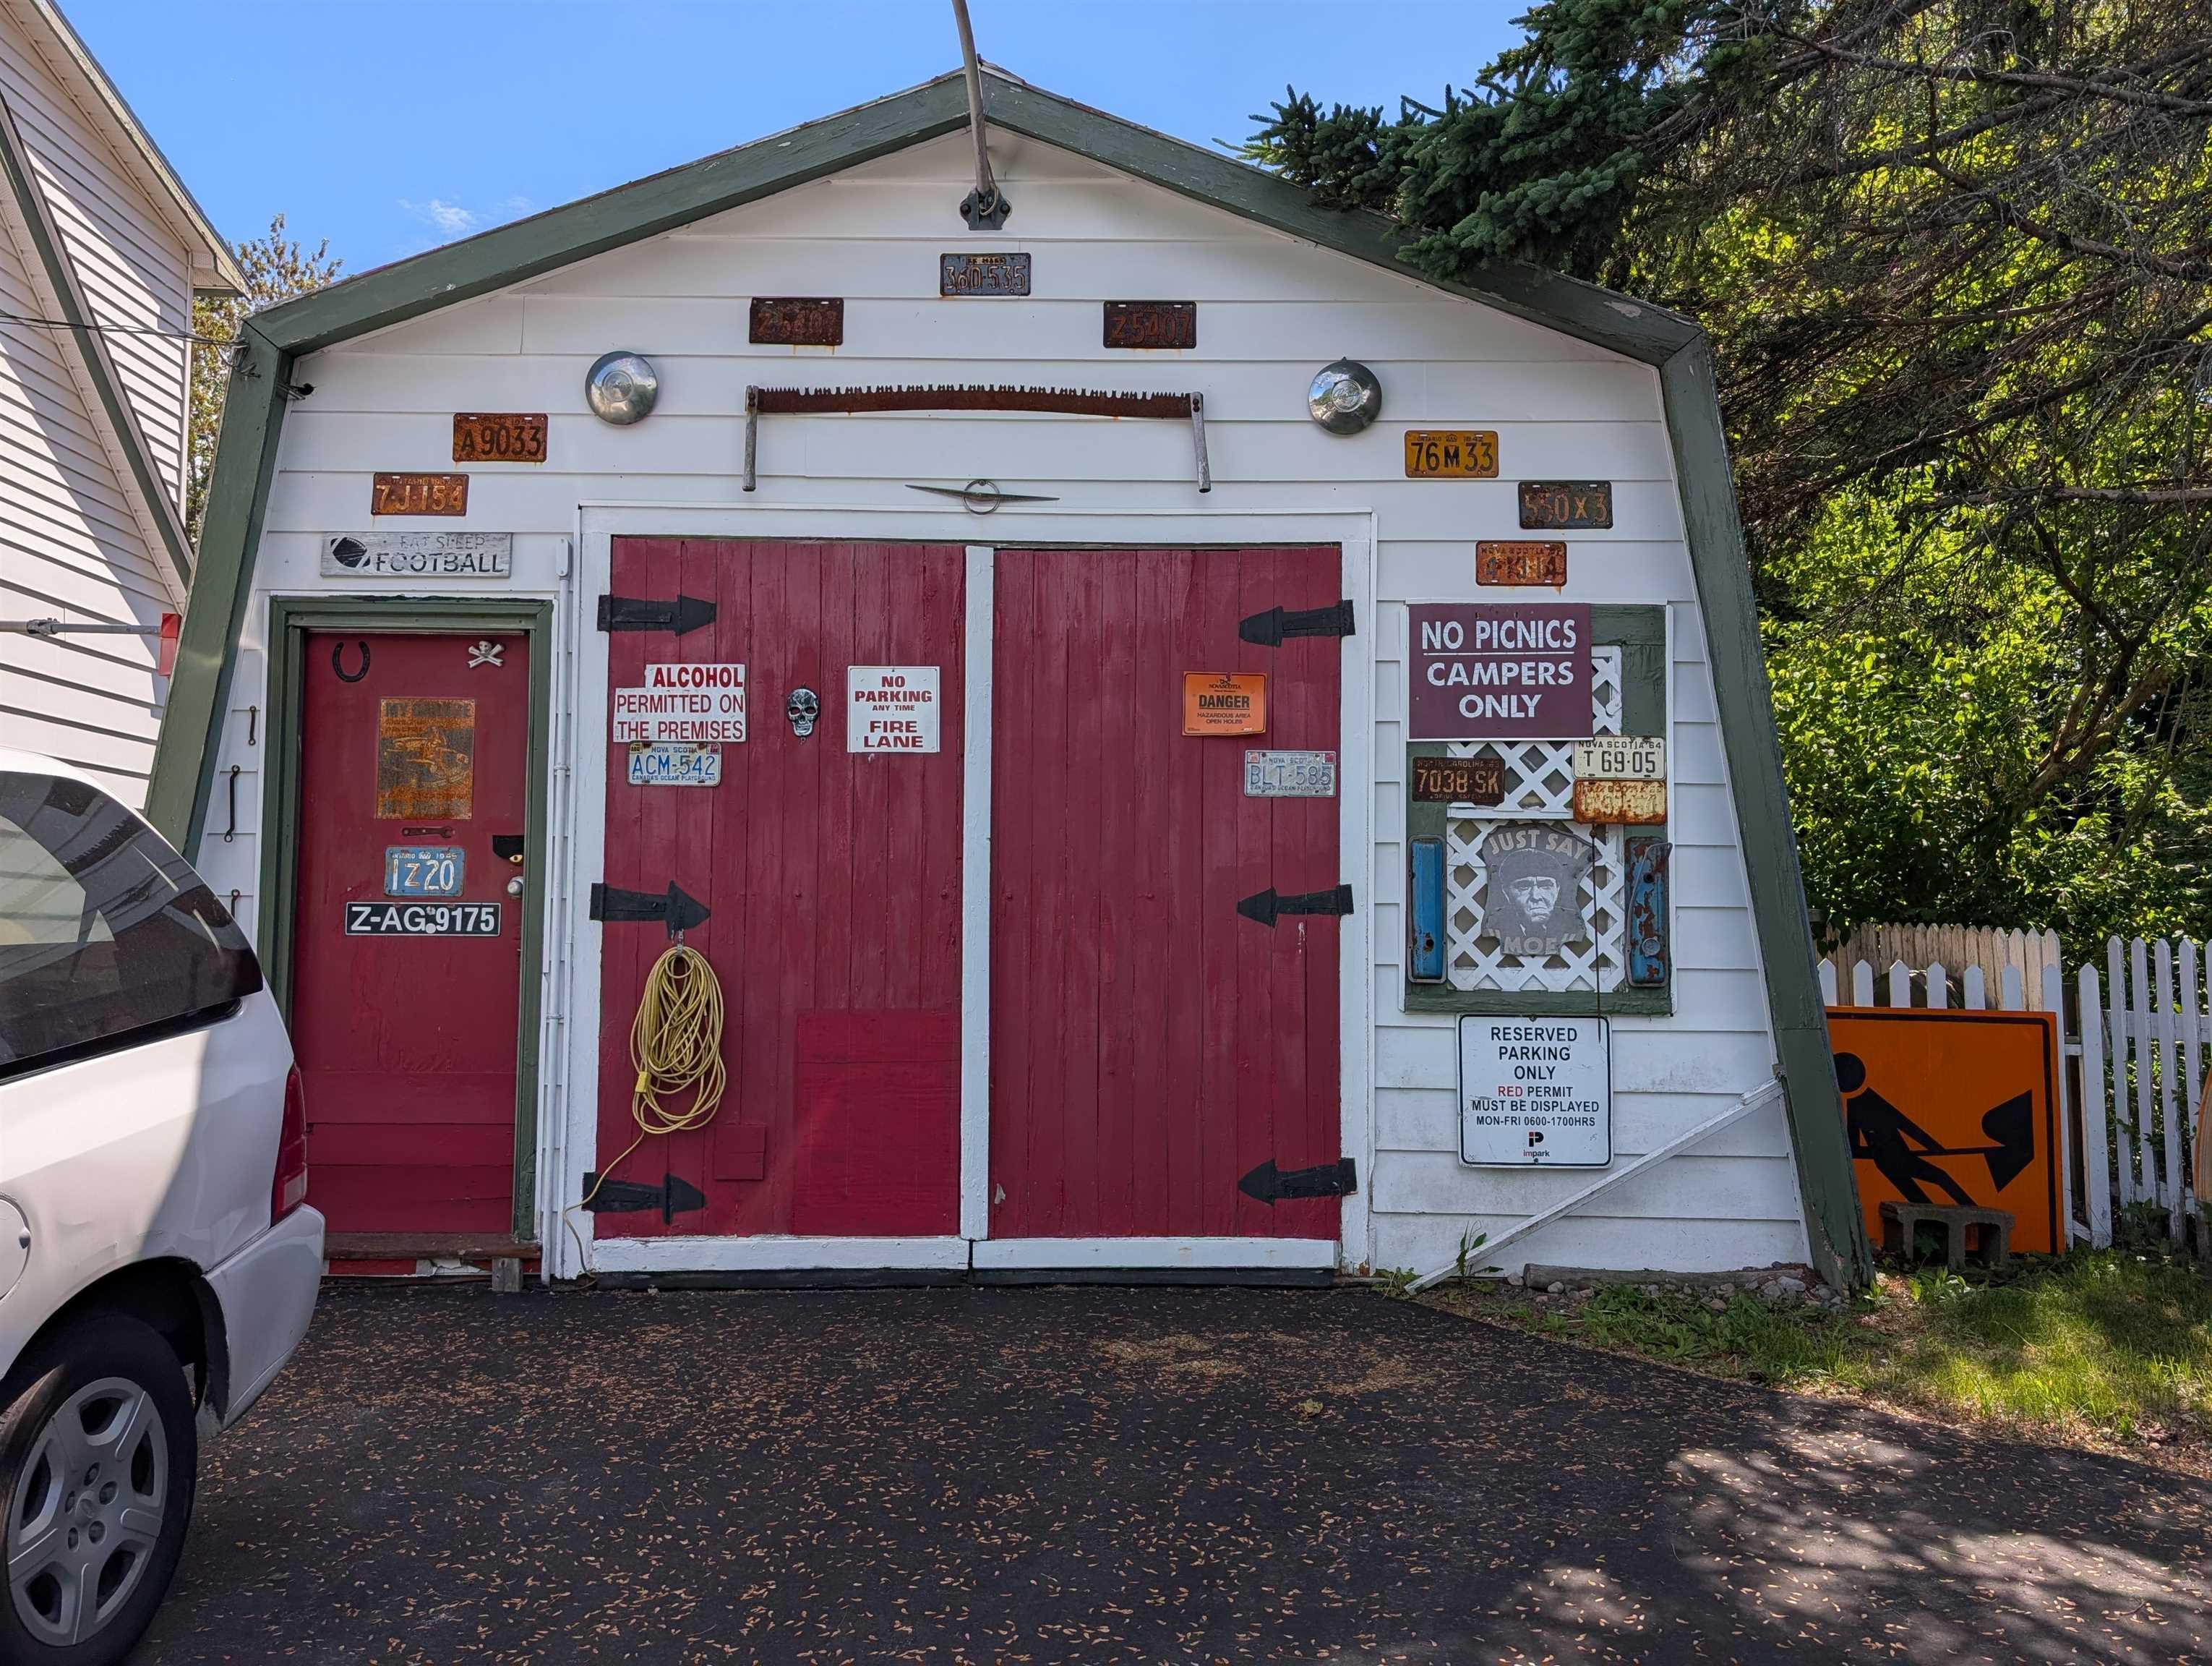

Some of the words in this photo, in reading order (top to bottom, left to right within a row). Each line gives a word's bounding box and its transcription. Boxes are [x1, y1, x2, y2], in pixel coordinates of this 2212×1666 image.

[460, 424, 541, 456] A9033
[375, 552, 505, 573] FOOTBALL
[1422, 620, 1464, 649] NO
[1475, 620, 1577, 649] PICNICS
[653, 667, 743, 688] ALCOHOL
[1427, 662, 1574, 686] CAMPERS
[881, 676, 906, 688] NO
[617, 694, 712, 713] PERMITTED
[719, 694, 743, 713] ON
[854, 691, 932, 702] PARKING
[1199, 695, 1250, 708] DANGER
[1459, 694, 1542, 718] ONLY
[617, 721, 650, 740] THE
[658, 720, 743, 740] PREMISES
[870, 720, 917, 733] FIRE
[864, 736, 923, 748] LANE
[632, 754, 716, 775] ACM-542
[1251, 765, 1332, 785] BLT-585
[1488, 829, 1540, 855] JUST
[1546, 833, 1590, 859] SAY
[1491, 1027, 1577, 1041] RESERVED
[1499, 1046, 1571, 1061] PARKING
[1514, 1065, 1556, 1080] ONLY
[1498, 1086, 1523, 1097] RED
[1527, 1086, 1573, 1097] PERMIT
[1472, 1100, 1506, 1111] MUST
[1511, 1101, 1527, 1111] BE
[1531, 1101, 1600, 1112] DISPLAYED
[1476, 1116, 1521, 1125] MON-FRI
[1524, 1116, 1595, 1127] 0600-1700HRS
[1523, 1150, 1551, 1158] impark
